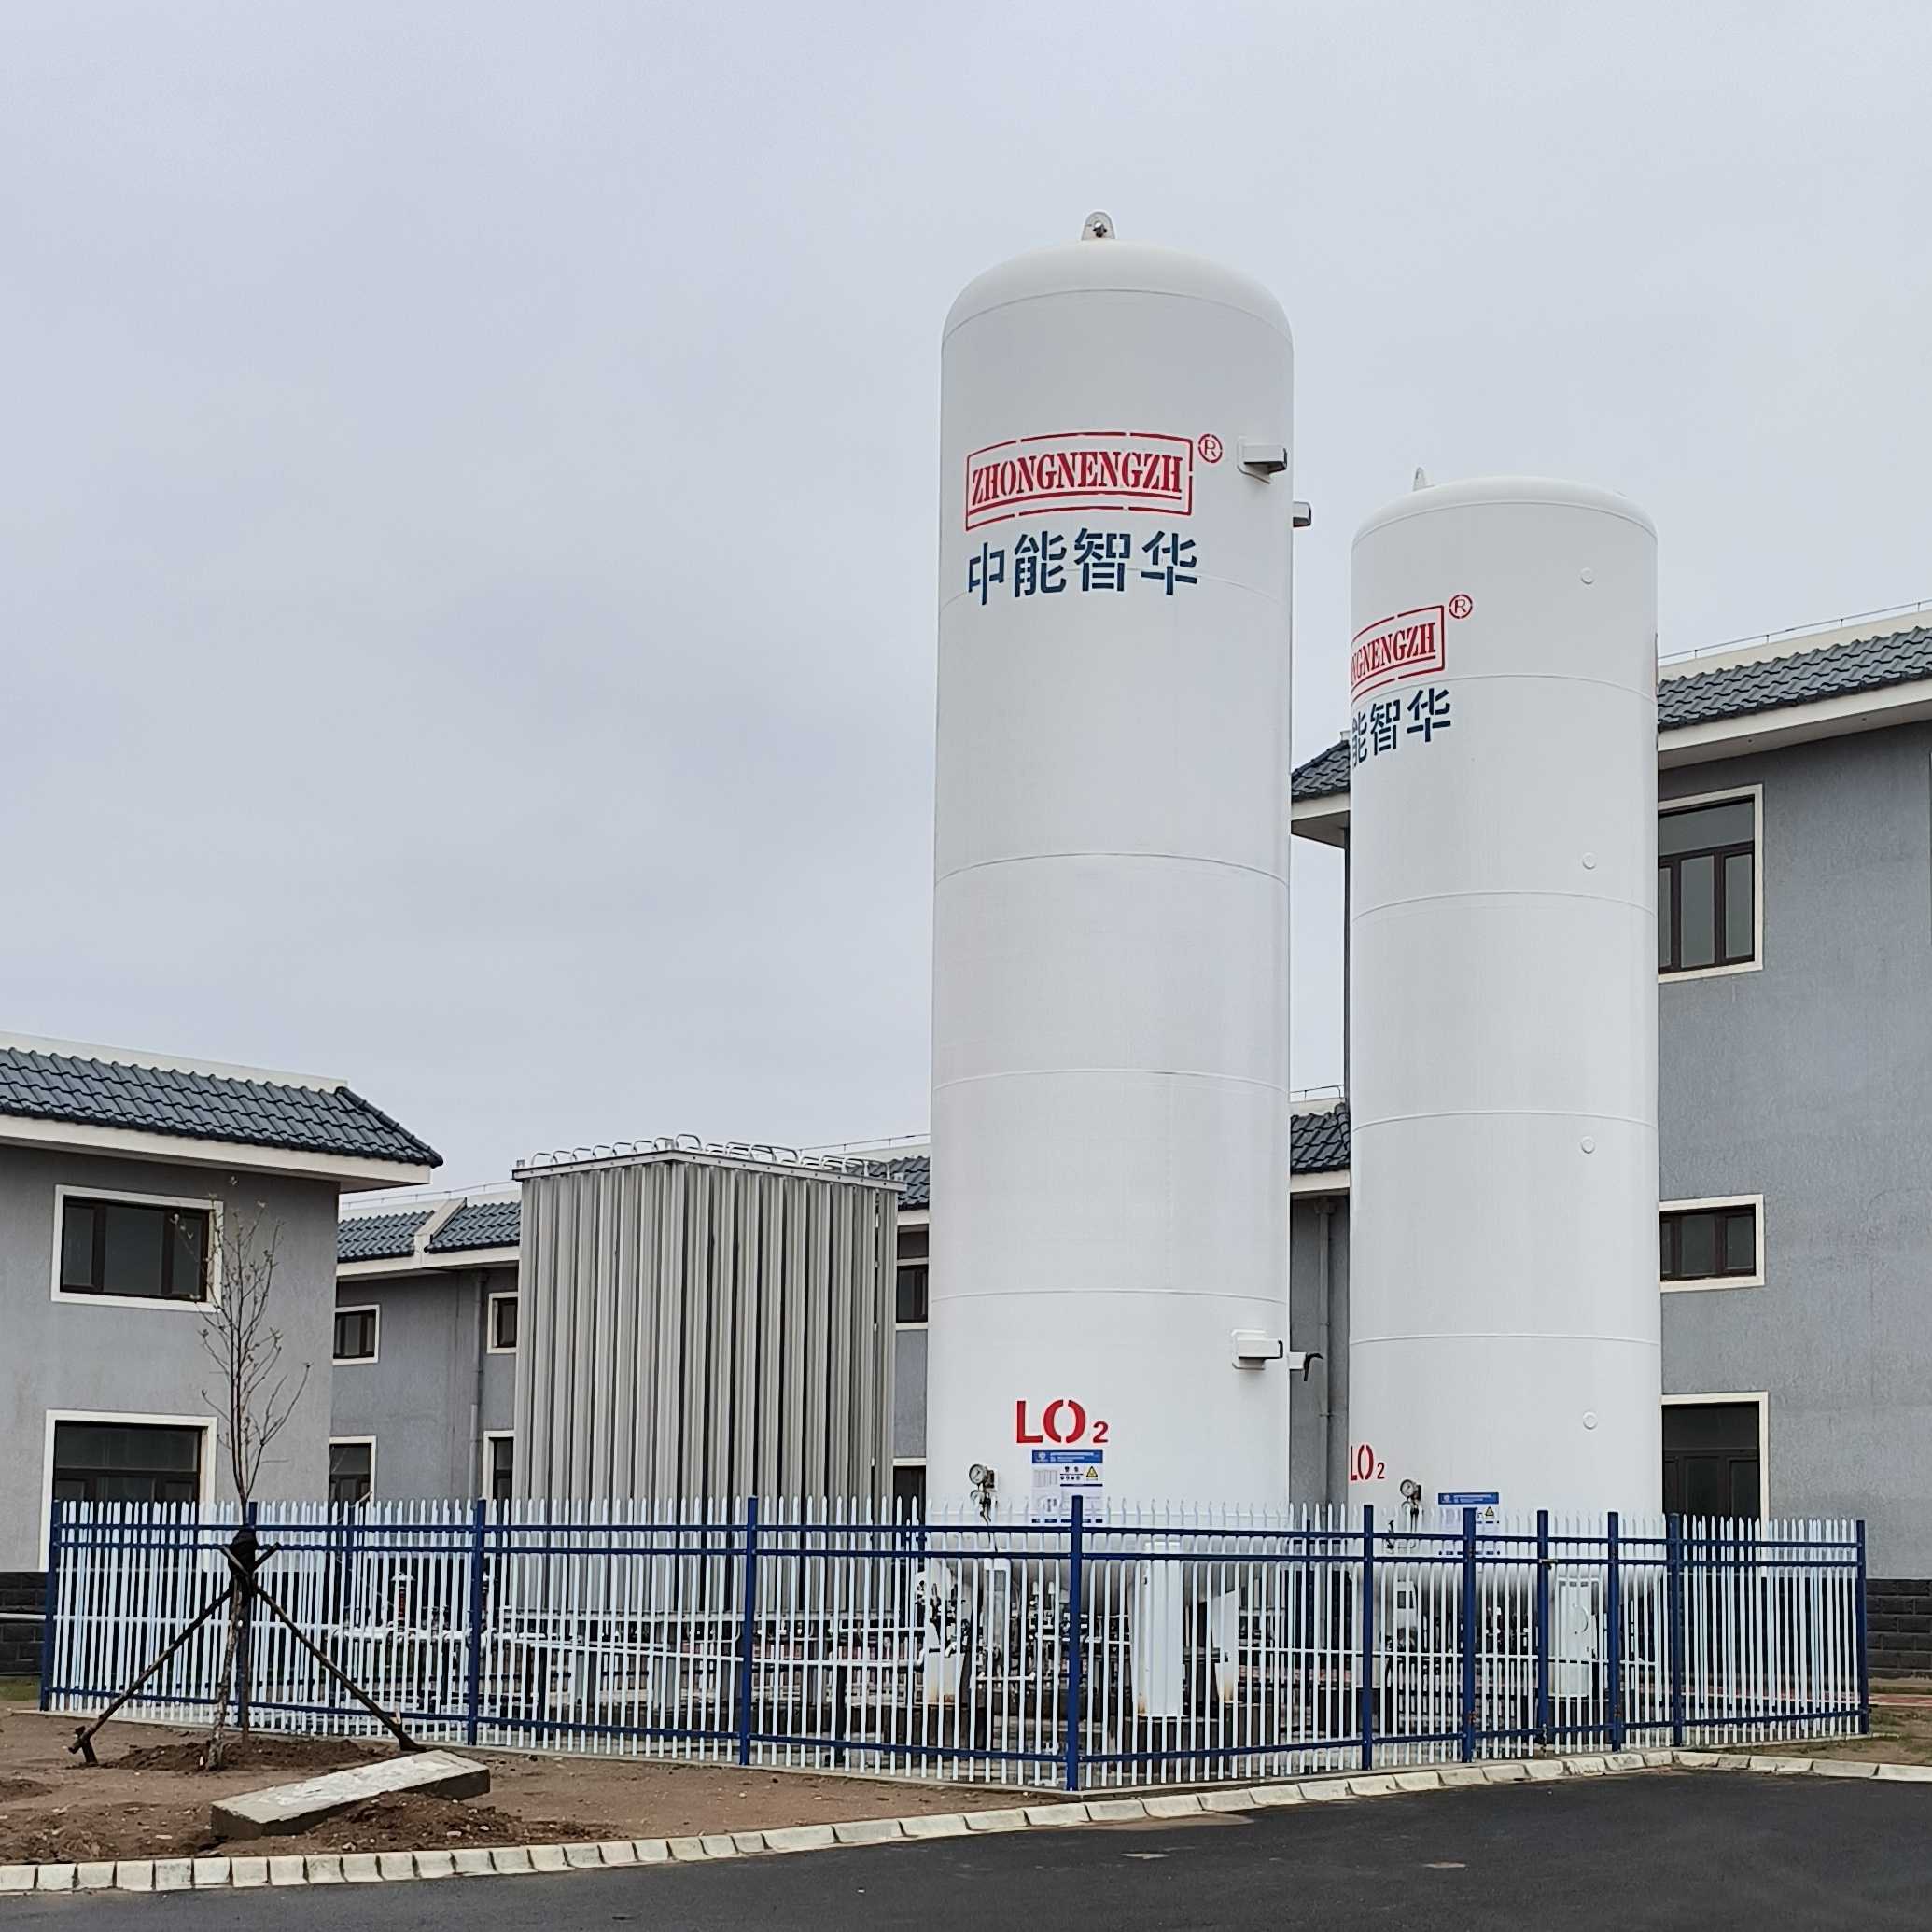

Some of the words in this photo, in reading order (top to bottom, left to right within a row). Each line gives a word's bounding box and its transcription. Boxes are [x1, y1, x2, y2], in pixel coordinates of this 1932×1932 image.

[972, 451, 1183, 506] ZHONGNENGZH
[968, 527, 1197, 605] 中能智华
